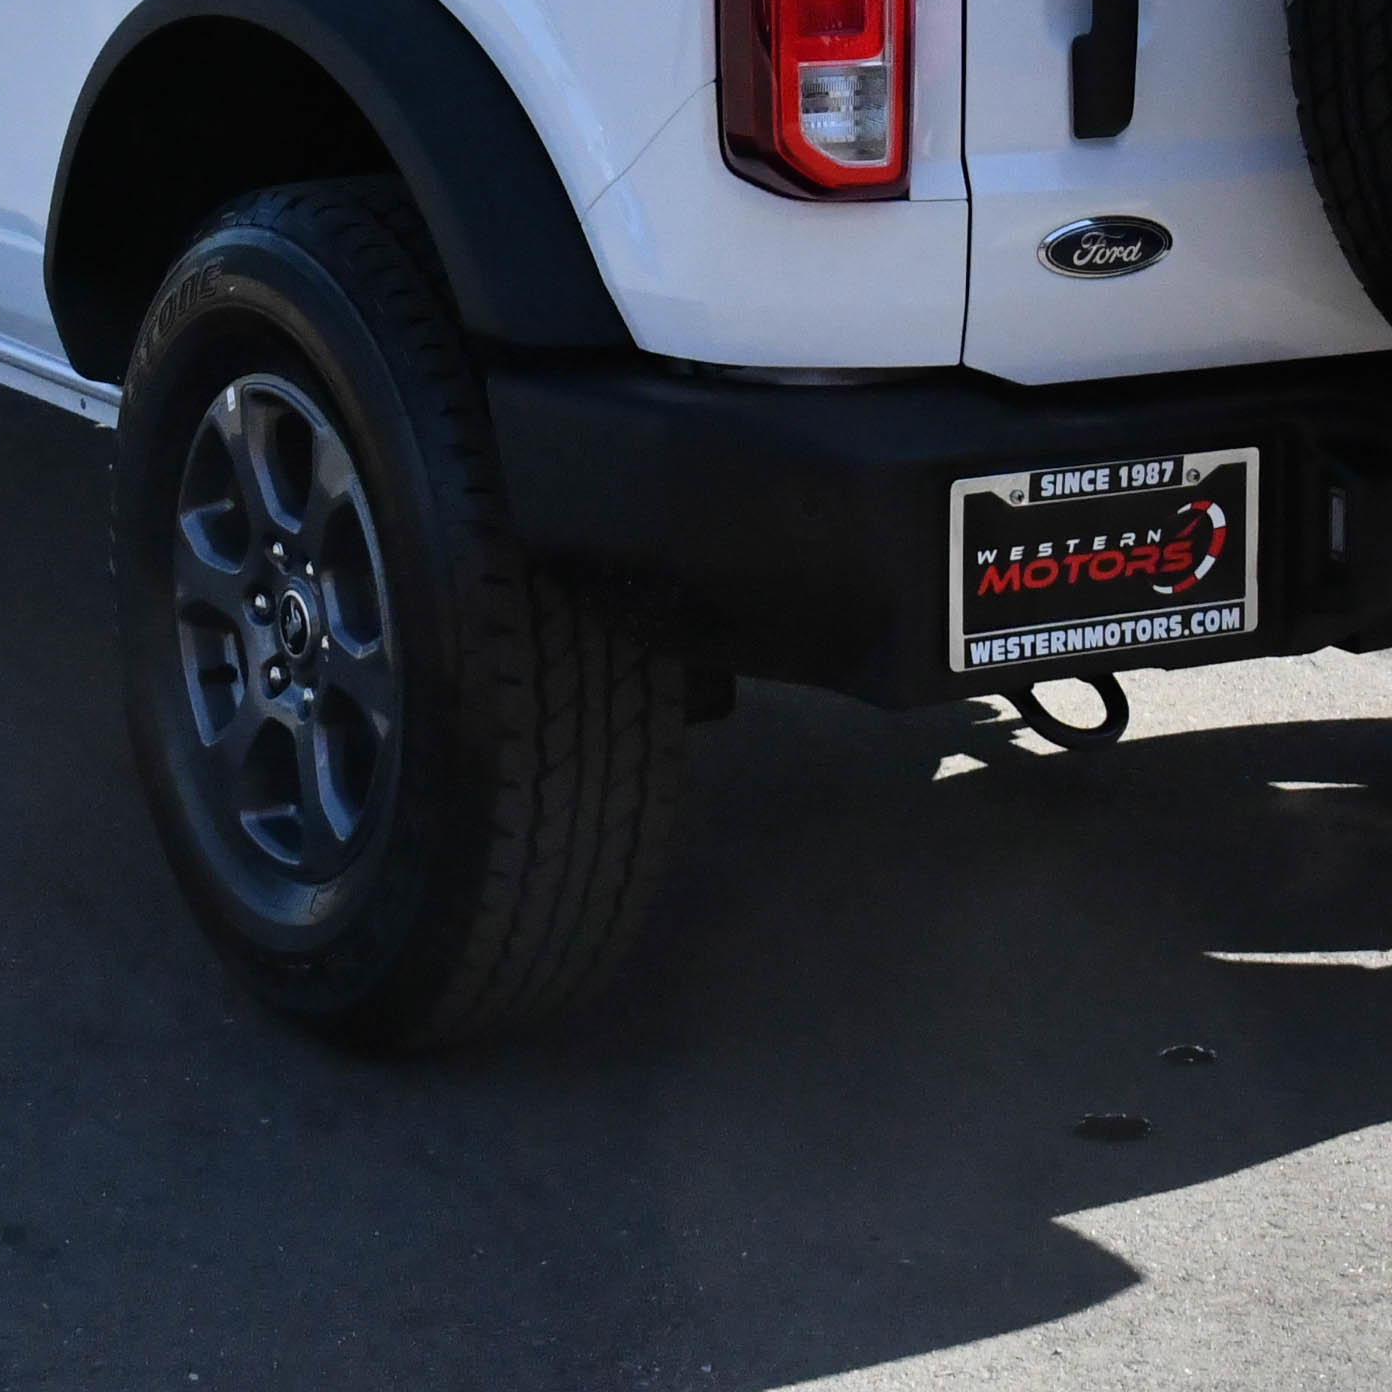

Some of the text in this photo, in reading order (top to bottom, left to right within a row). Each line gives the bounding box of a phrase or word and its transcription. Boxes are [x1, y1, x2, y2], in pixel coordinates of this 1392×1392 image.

[1072, 231, 1143, 266] Ford
[1040, 460, 1174, 497] SINCE 1987
[976, 528, 1163, 566] WESTERN
[975, 540, 1194, 596] MOTORS
[970, 607, 1241, 665] WESTERNMOTORS.COM
